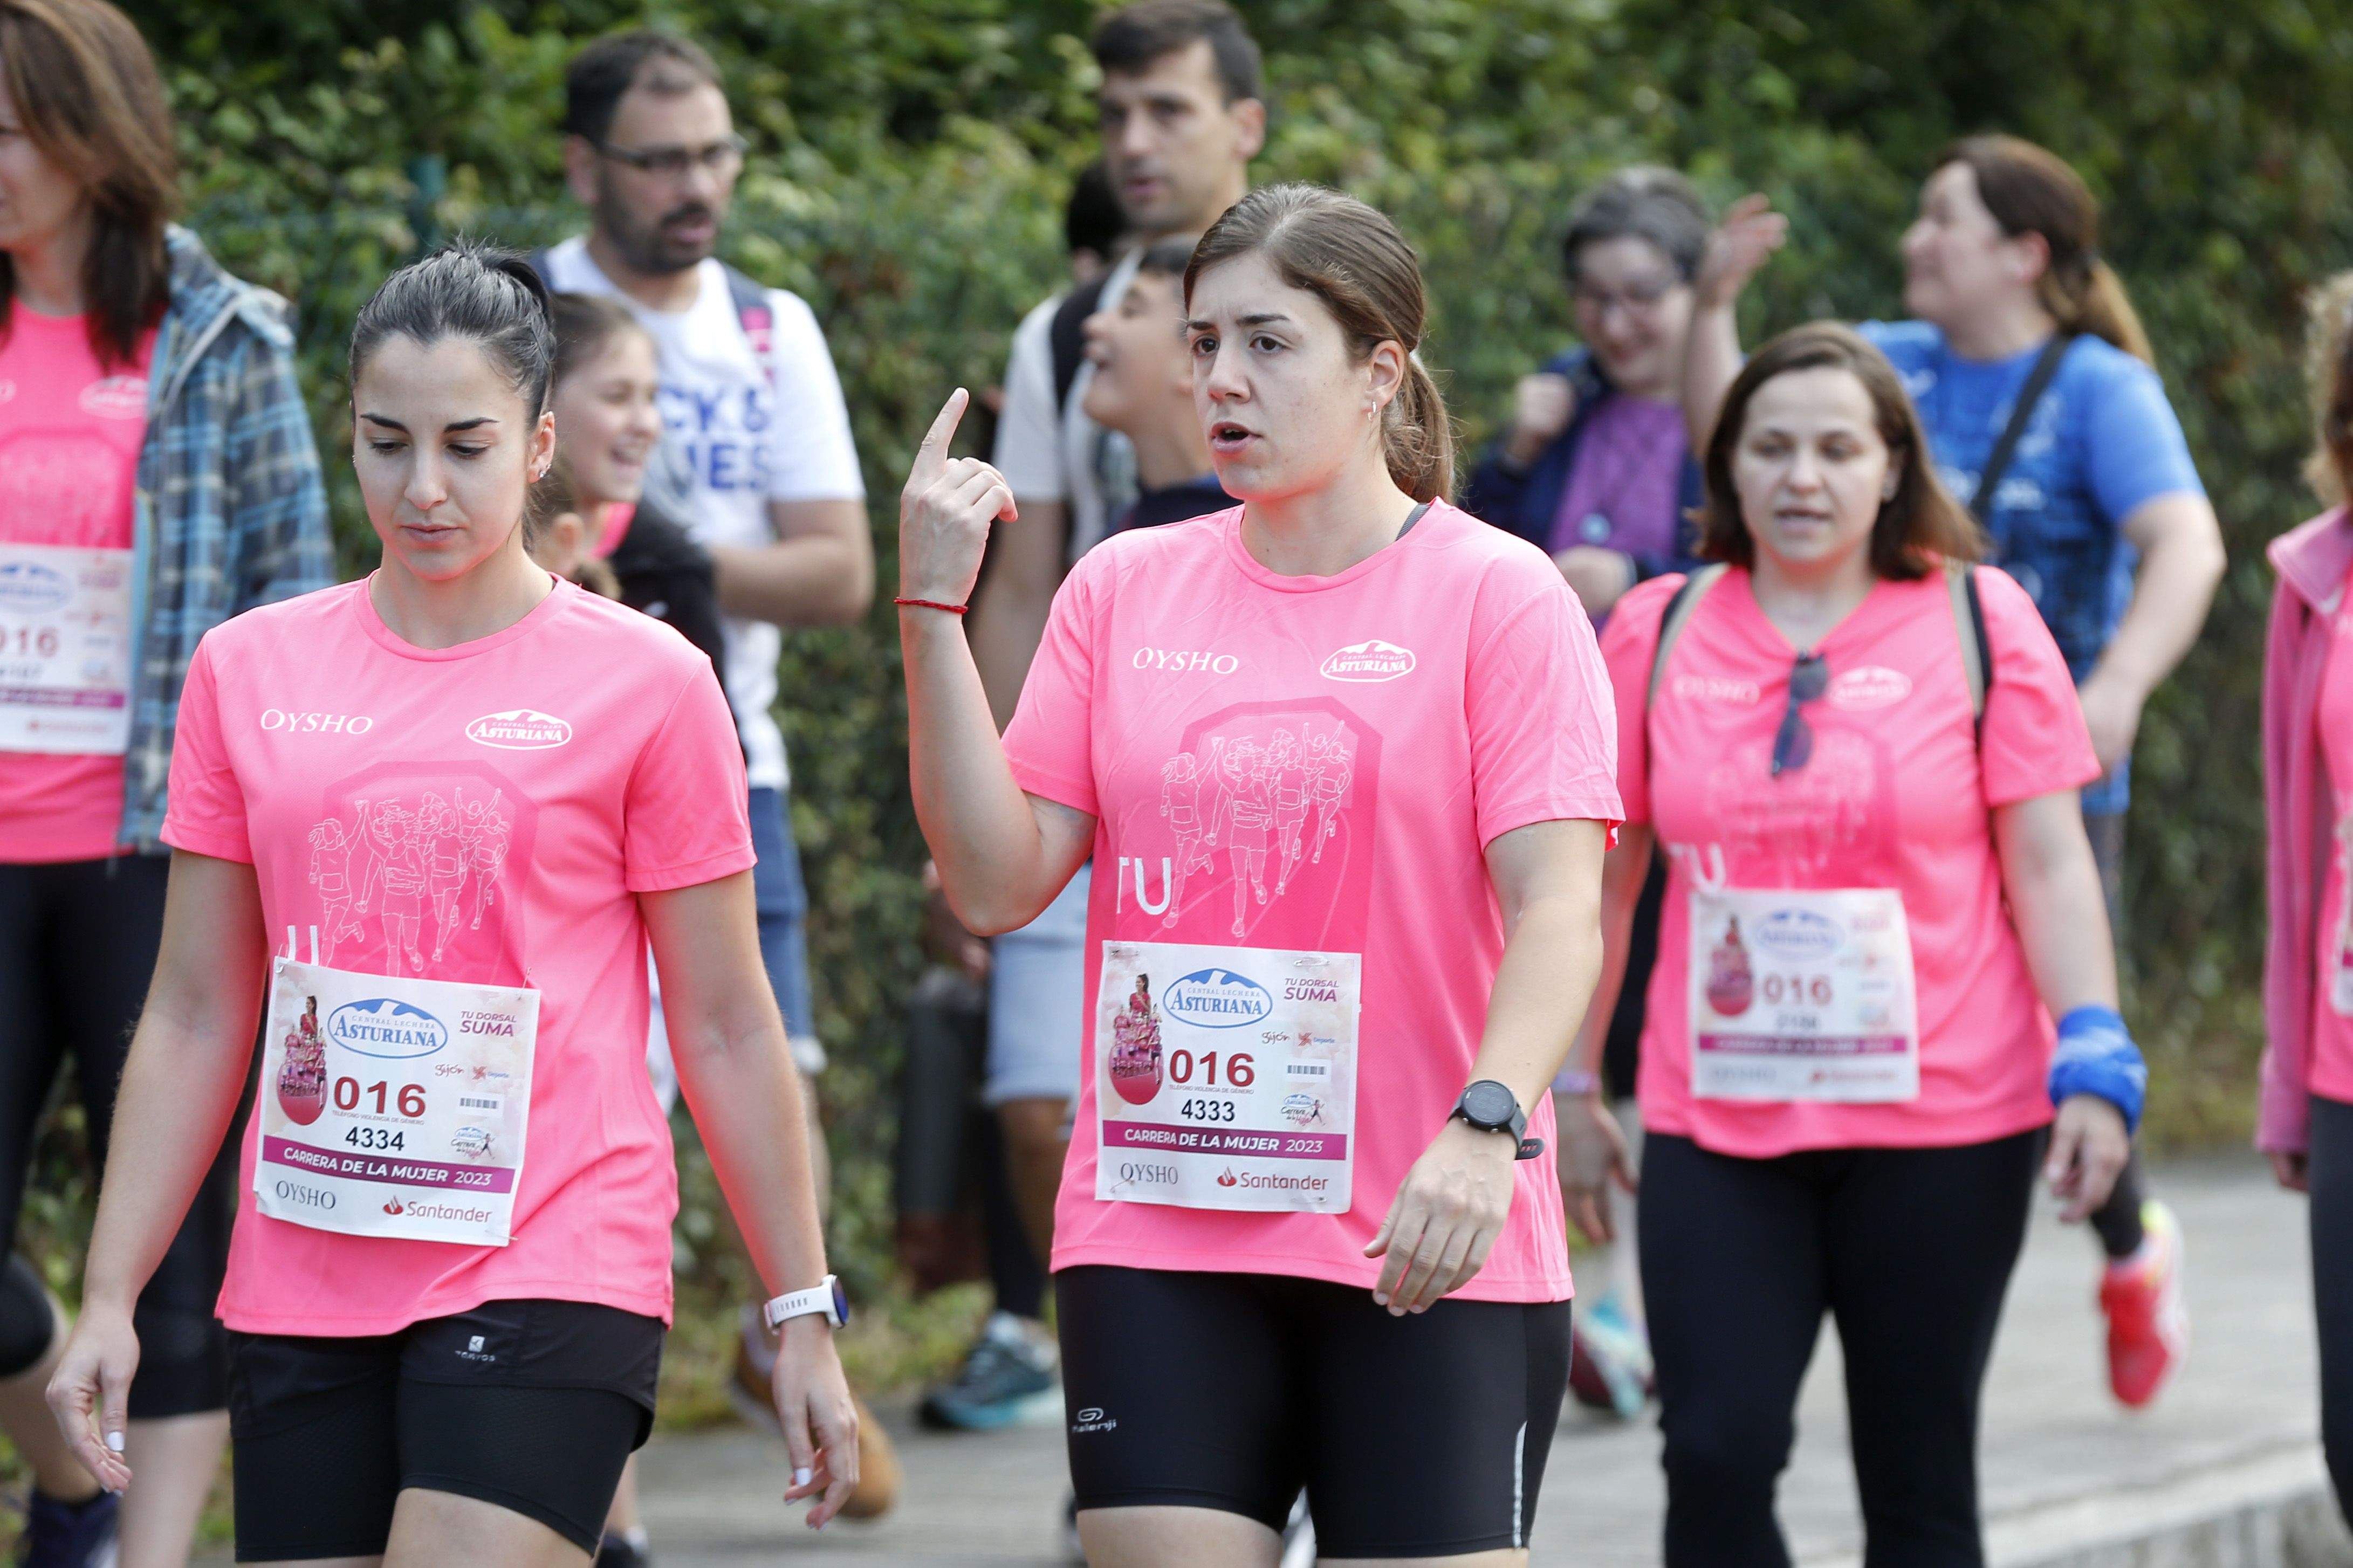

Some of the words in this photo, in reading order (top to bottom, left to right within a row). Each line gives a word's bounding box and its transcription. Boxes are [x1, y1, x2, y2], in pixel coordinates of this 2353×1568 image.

[1133, 647, 1239, 674] OYSHO
[1326, 657, 1407, 673] ASTURIANA
[260, 709, 373, 734] OYSHO
[472, 722, 562, 741] ASTURIANA
[1223, 989, 1261, 997] LECHERA
[1284, 987, 1336, 1002] SUMA
[1299, 979, 1339, 987] DORSAL
[1764, 973, 1835, 1007] 016
[1170, 988, 1263, 1015] ASTURIANA
[352, 1015, 391, 1024] CENTRAL
[395, 1020, 435, 1029] LECHERA
[461, 1010, 474, 1019] TU
[476, 1012, 517, 1022] DORSAL
[334, 1015, 437, 1047] ASTURIANA
[459, 1020, 513, 1036] SUMA
[1170, 1049, 1255, 1087] 016
[334, 1076, 426, 1118] 016
[1181, 1099, 1234, 1122] 4333
[345, 1126, 404, 1151] 4334
[1124, 1129, 1177, 1144] CARRERA
[1179, 1134, 1198, 1146] DE
[1200, 1135, 1220, 1149] LA
[1224, 1136, 1279, 1151] MUJER
[1285, 1139, 1323, 1153] 2023
[284, 1147, 338, 1170] CARRERA
[341, 1159, 364, 1174] DE
[366, 1162, 388, 1177] LA
[391, 1165, 448, 1182] MUJER
[454, 1171, 492, 1186] 2023
[1120, 1163, 1178, 1185] OYSHO
[1240, 1172, 1328, 1191] Santander
[276, 1180, 336, 1209] OYSHO
[407, 1201, 492, 1223] Santander
